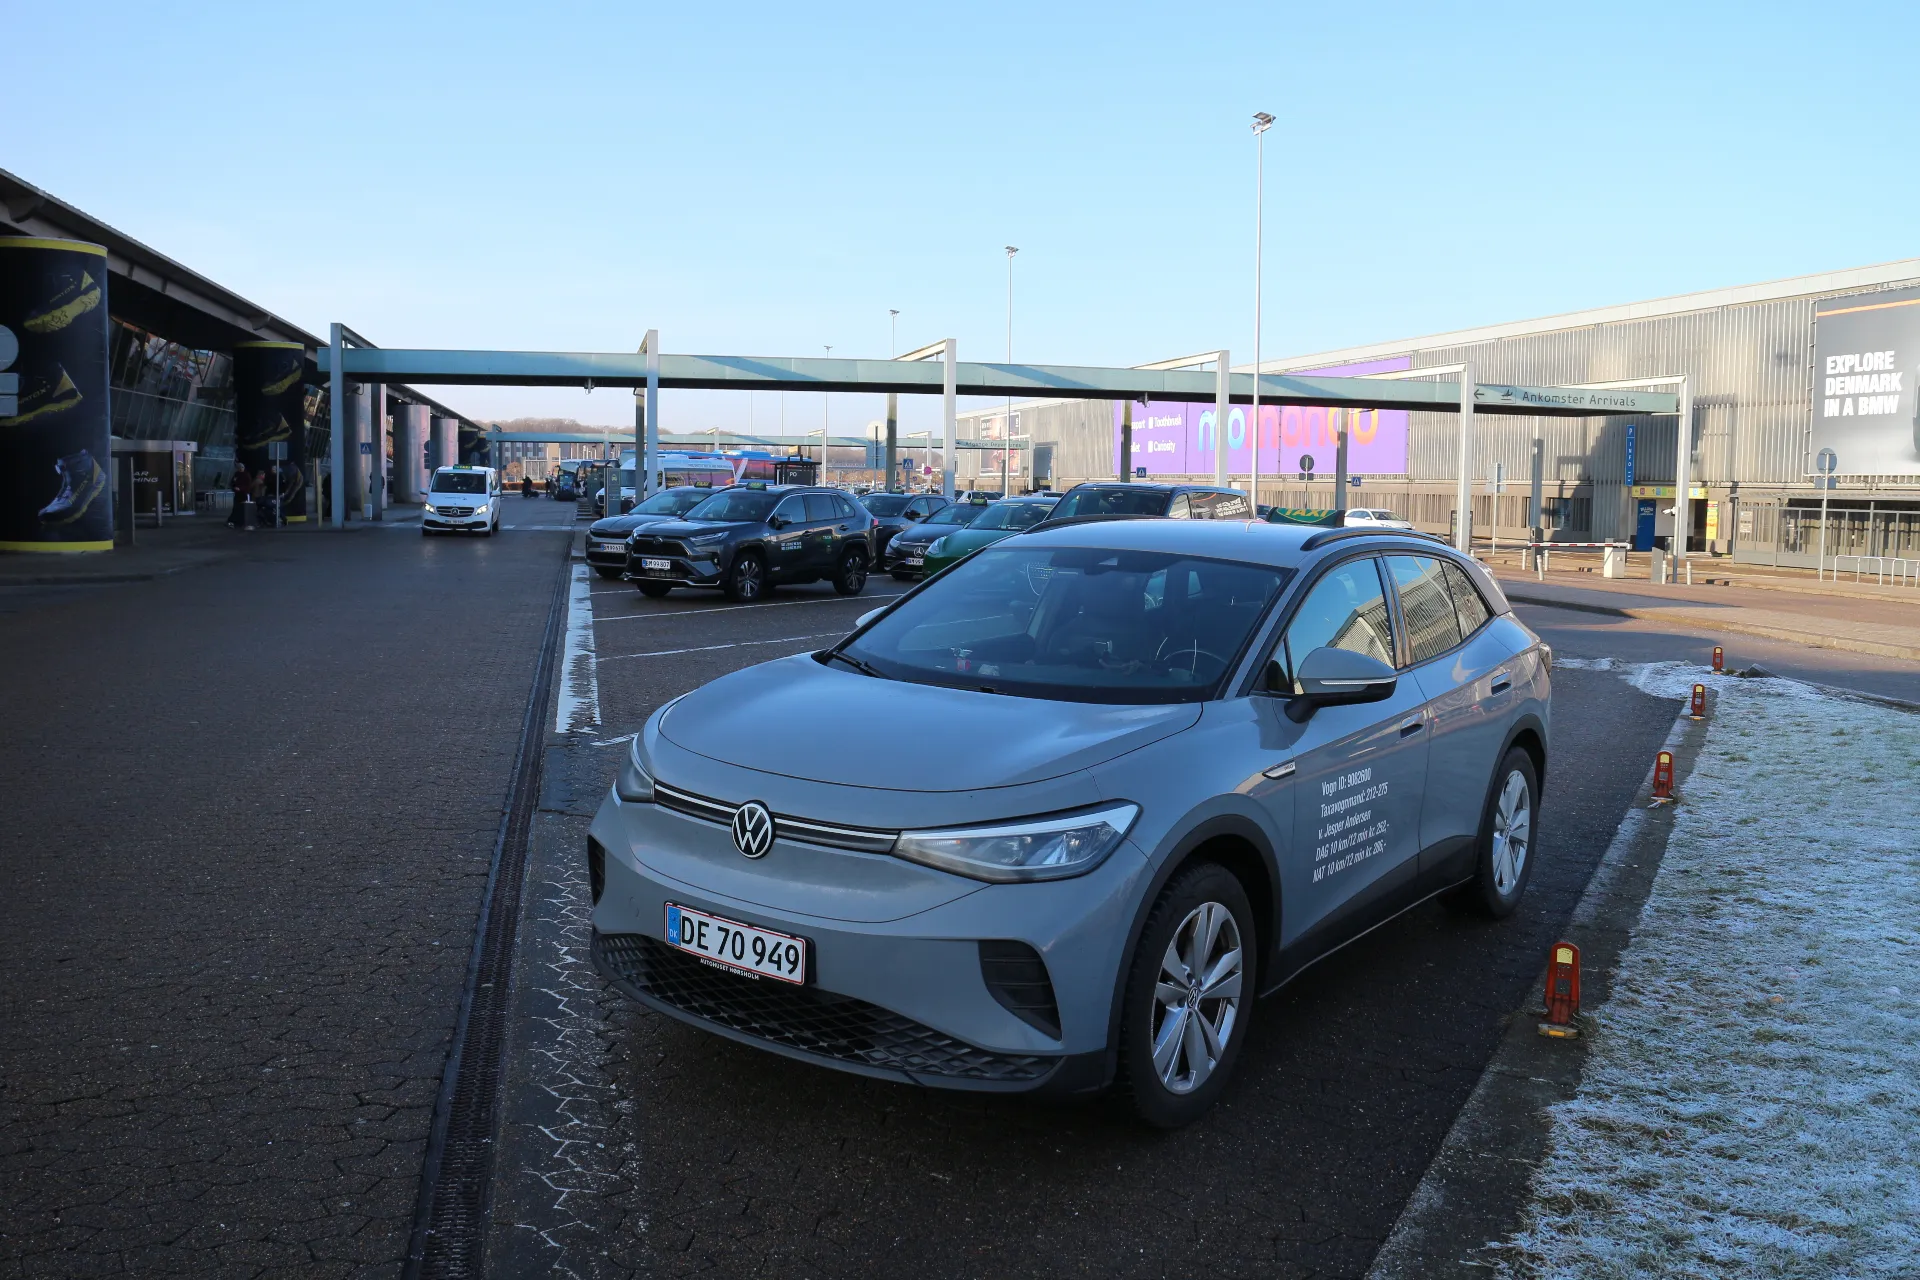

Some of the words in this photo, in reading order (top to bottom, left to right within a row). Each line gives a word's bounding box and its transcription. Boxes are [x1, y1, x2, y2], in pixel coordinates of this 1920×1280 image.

[1826, 350, 1895, 375] EXPLORE
[1825, 371, 1903, 396] DENMARK
[1522, 391, 1585, 405] Ankomster
[1589, 394, 1636, 407] Arrivals
[1824, 398, 1840, 417] IN
[1842, 397, 1855, 416] A
[1858, 394, 1900, 415] BMW
[1154, 414, 1182, 428] Toothbrush
[1153, 440, 1176, 454] Curiosity
[1285, 508, 1330, 518] TAXI
[1321, 781, 1337, 796] Vogn
[1338, 775, 1347, 790] ID:
[1365, 782, 1389, 801] 212-275
[1324, 820, 1345, 837] Jesper
[1344, 809, 1372, 830] Andersen
[1315, 843, 1330, 862] DAG
[1330, 840, 1338, 855] 10
[1357, 827, 1369, 844] min
[1312, 864, 1326, 884] NAT
[1327, 861, 1335, 876] 10
[1354, 848, 1365, 864] min
[669, 928, 678, 940] DK
[681, 915, 710, 952] DE
[717, 925, 745, 961] 70
[752, 935, 800, 975] 949
[700, 957, 729, 972] AUTOHUSET
[729, 966, 760, 981] HØRSHOLM
